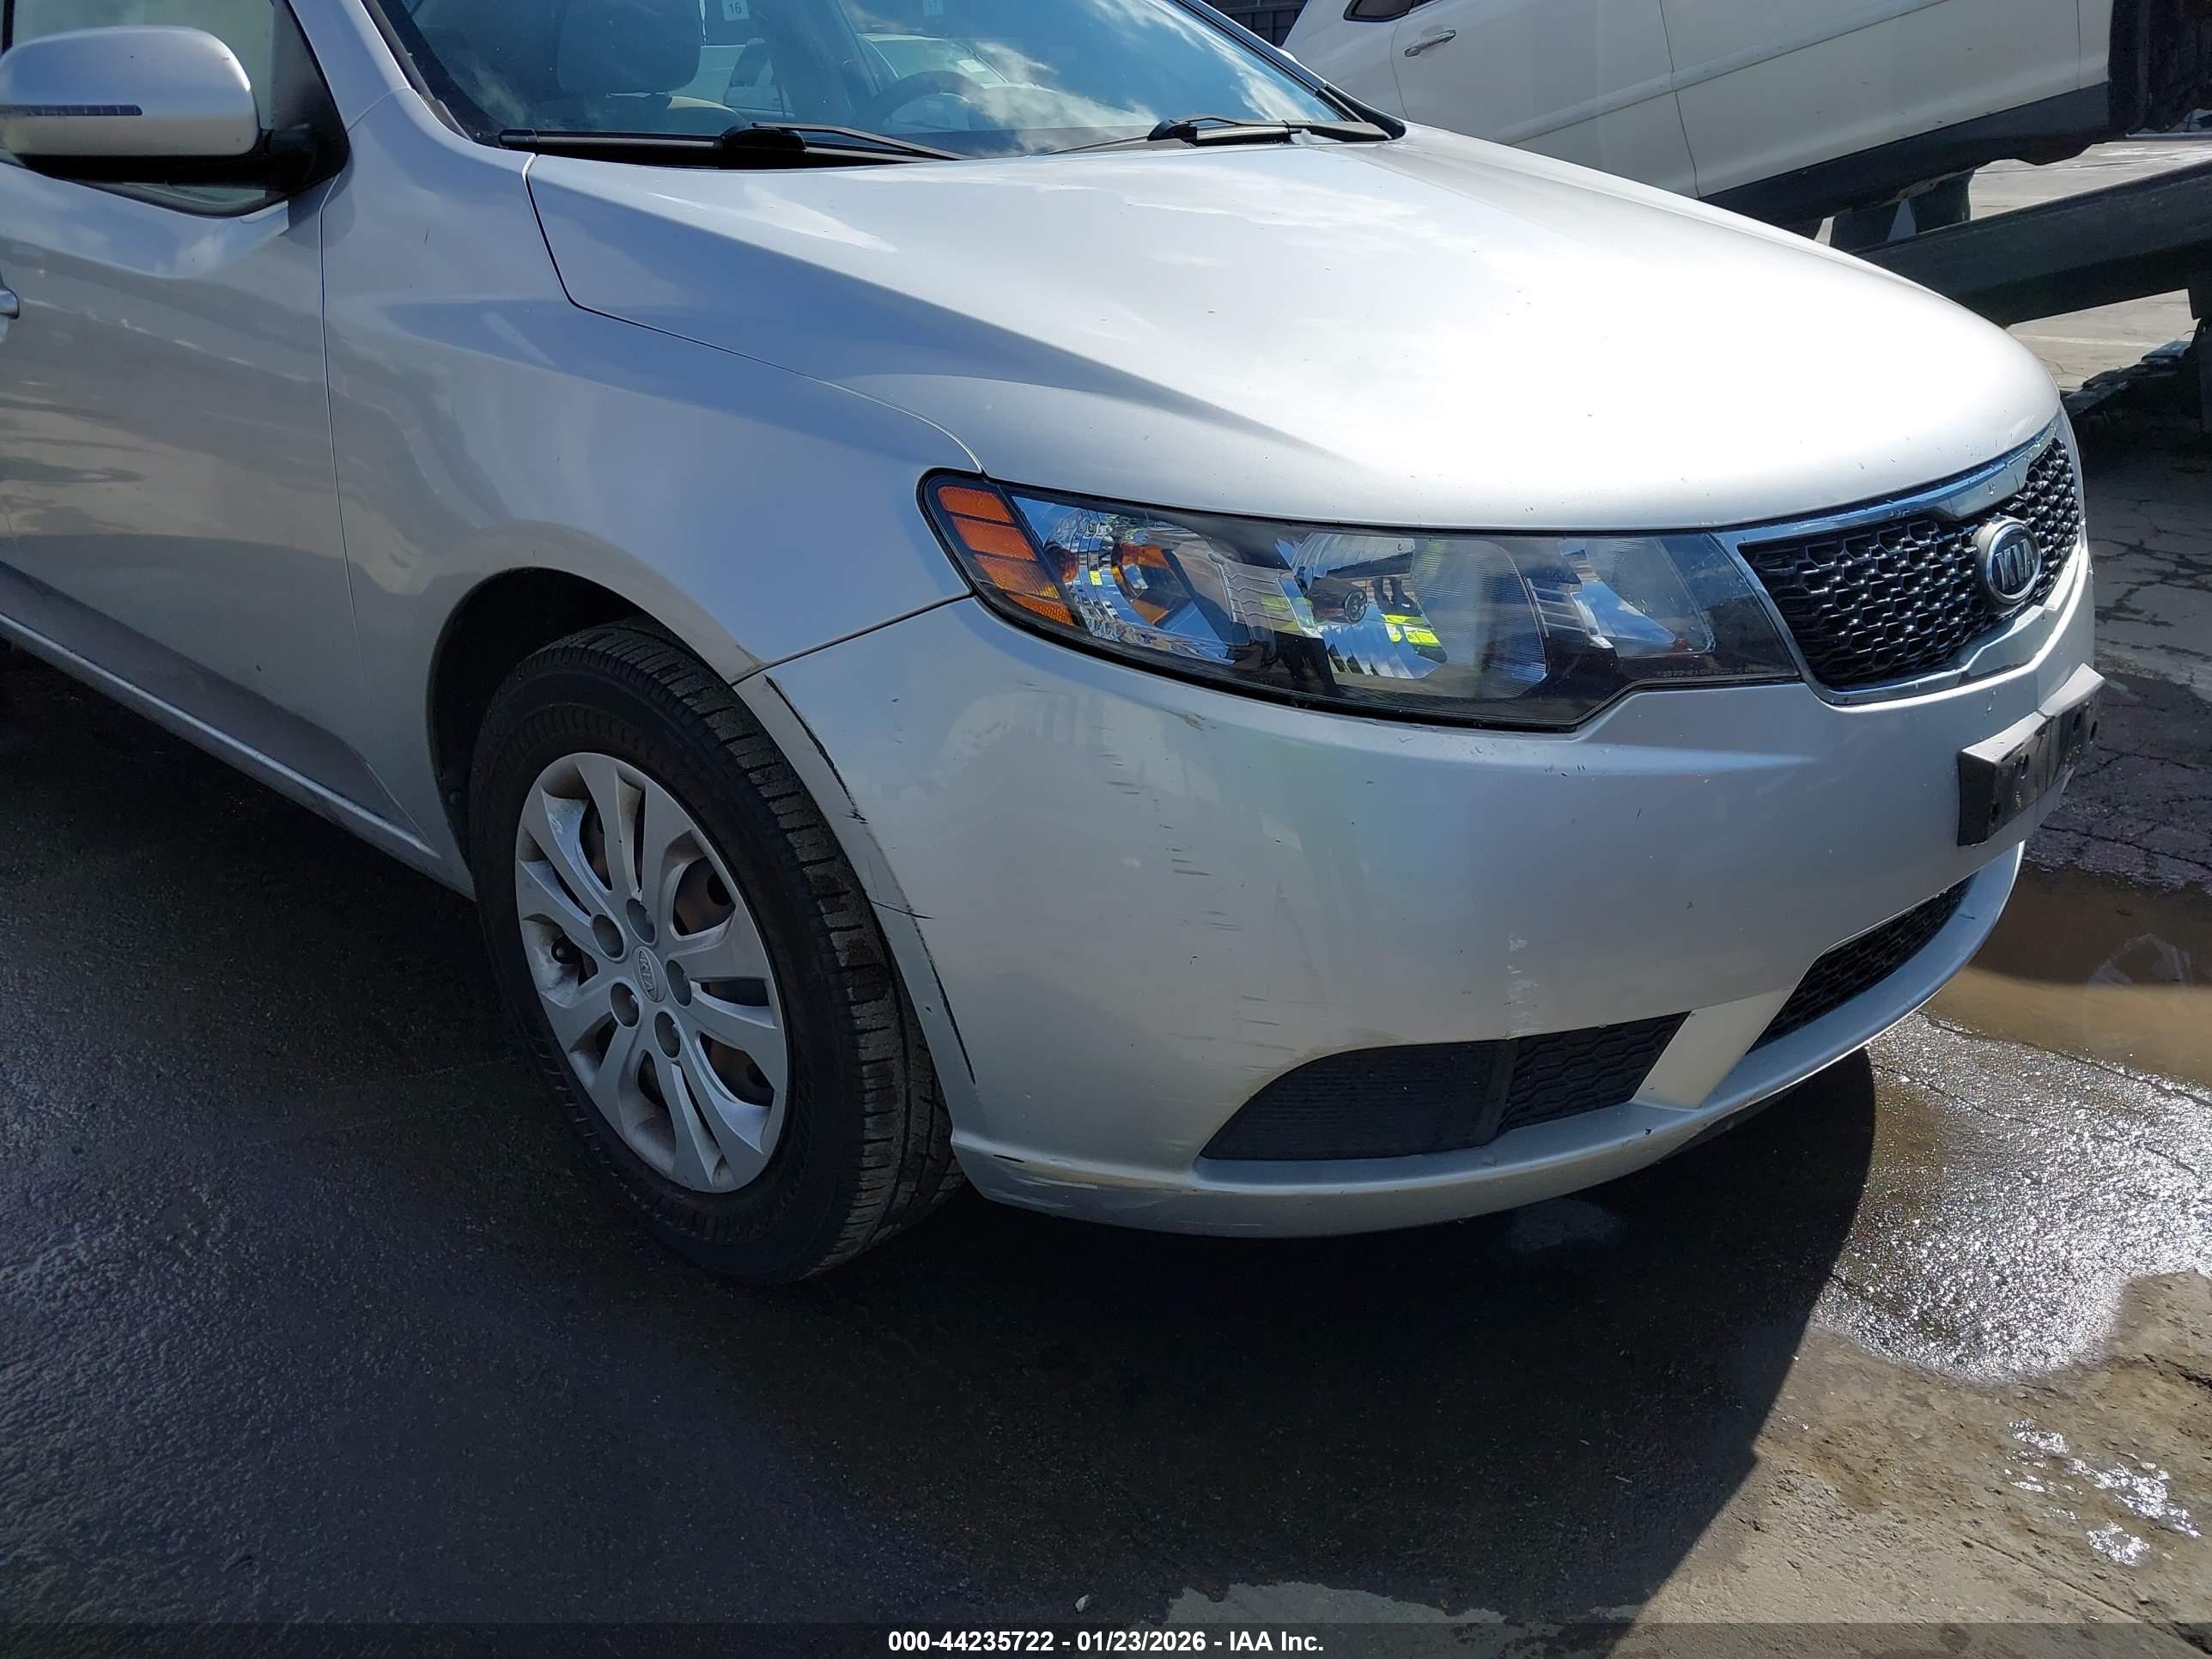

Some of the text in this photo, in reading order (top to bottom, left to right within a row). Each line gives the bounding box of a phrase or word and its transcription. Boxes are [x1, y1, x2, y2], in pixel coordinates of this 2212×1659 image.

[728, 2, 743, 15] 16
[1994, 538, 2037, 591] KIA
[638, 957, 654, 992] KIA
